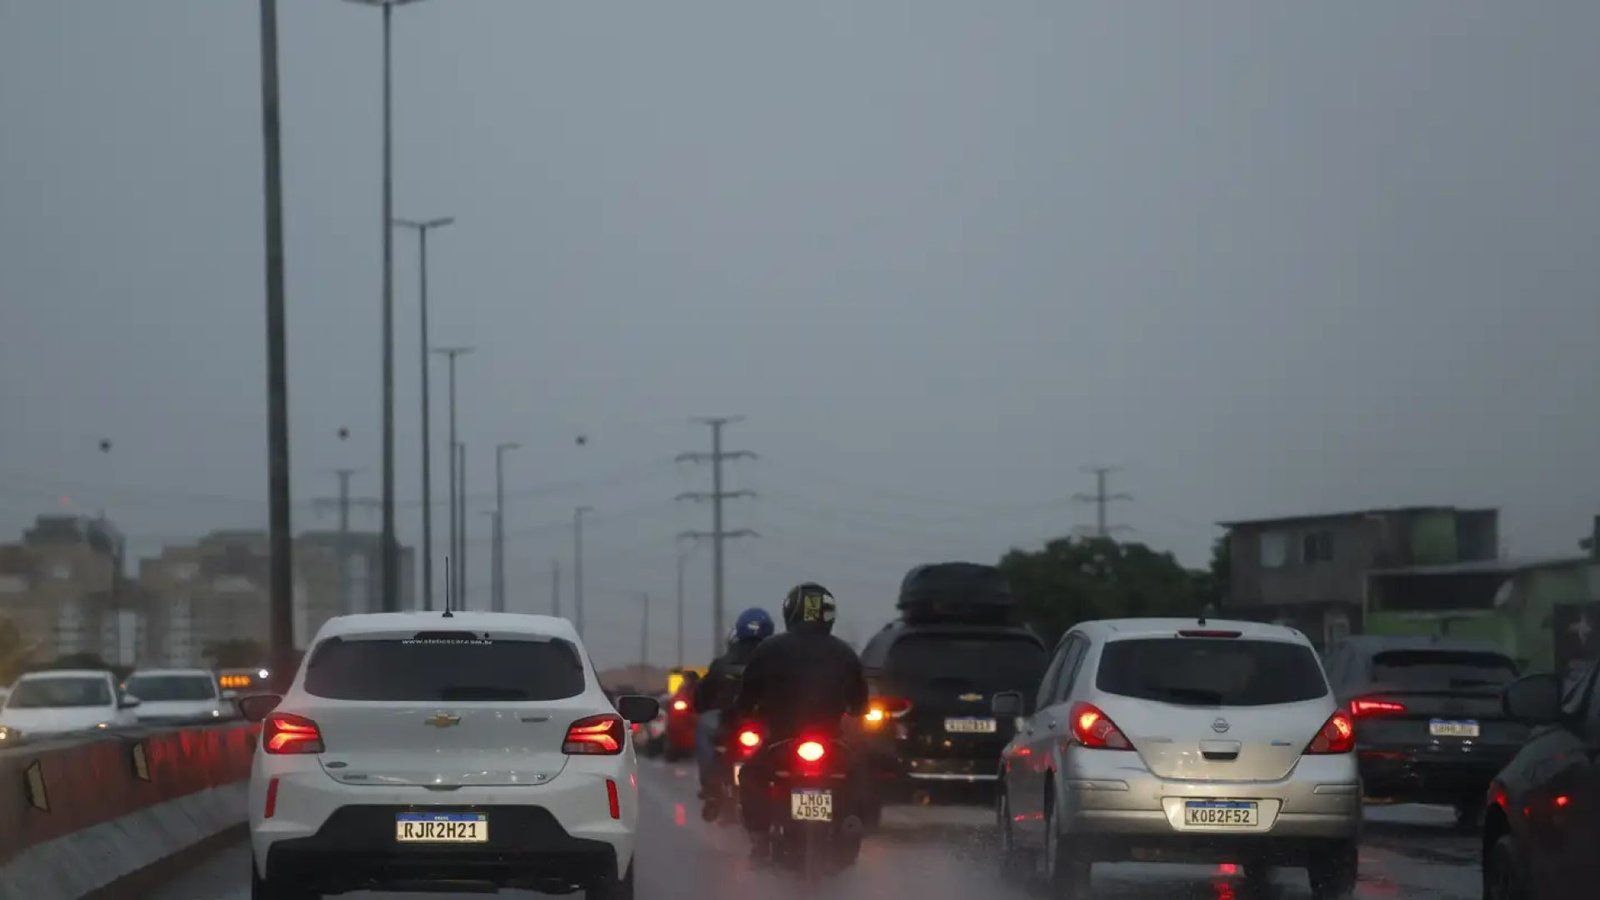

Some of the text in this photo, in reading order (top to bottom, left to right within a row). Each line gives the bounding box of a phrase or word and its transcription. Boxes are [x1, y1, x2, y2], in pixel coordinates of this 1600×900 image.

[800, 794, 823, 806] LMO
[797, 806, 827, 818] 4D59
[1191, 809, 1250, 823] KOB2F52
[404, 822, 477, 838] RJR2H21
